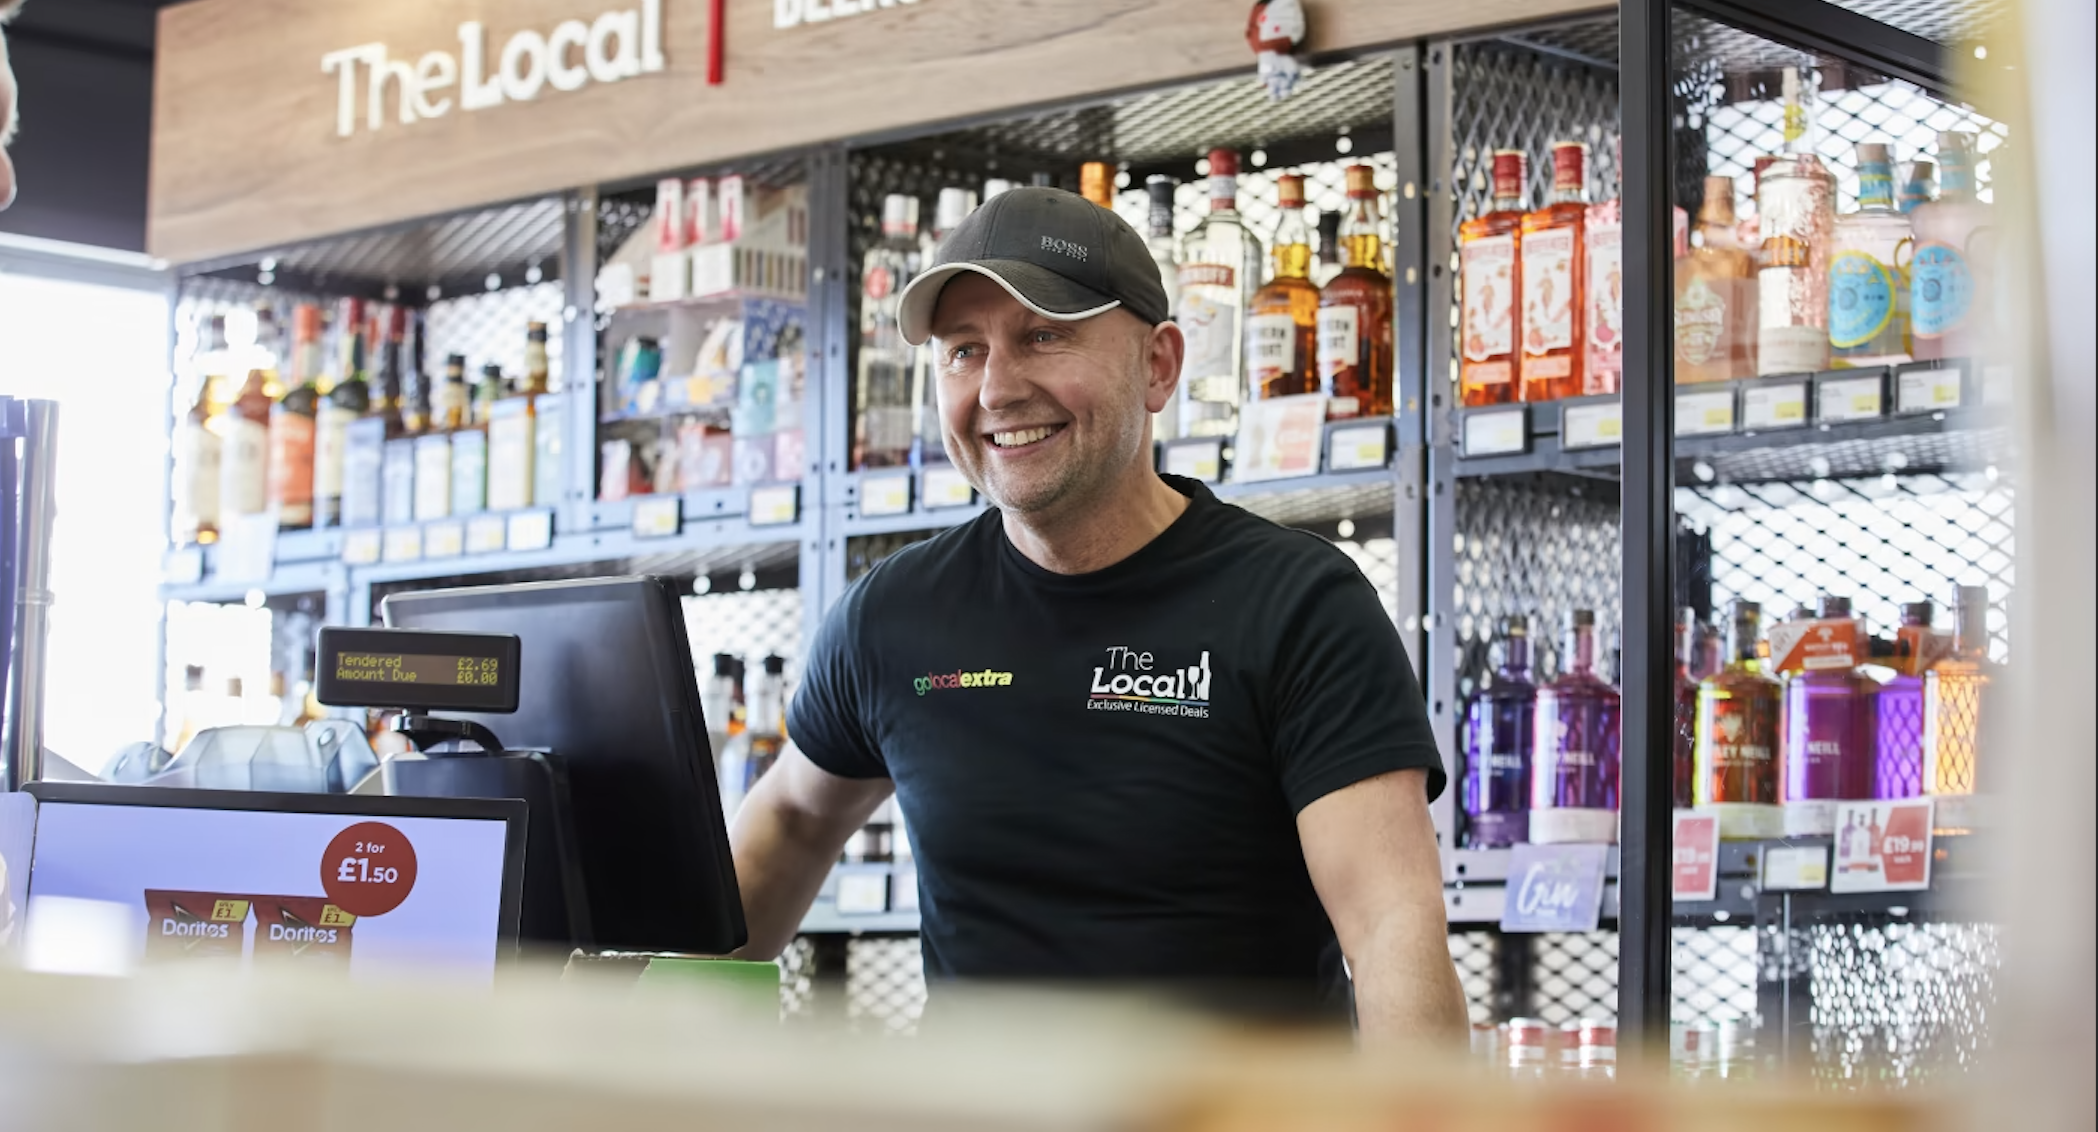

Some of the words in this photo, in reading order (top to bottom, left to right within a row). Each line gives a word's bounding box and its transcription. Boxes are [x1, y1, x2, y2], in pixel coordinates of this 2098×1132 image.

[321, 42, 457, 137] The
[457, 0, 664, 111] Local
[1040, 235, 1087, 257] BOSS
[337, 652, 402, 668] Tendered
[457, 657, 499, 671] £2.69
[1105, 645, 1154, 671] The
[336, 667, 385, 681] Amount
[392, 668, 417, 682] Due
[456, 671, 499, 685] £0.00
[1091, 666, 1186, 699] Local
[1086, 699, 1133, 711] Exclusive
[1133, 701, 1179, 716] Licensed
[1180, 705, 1210, 718] Deals
[355, 841, 364, 854] 2
[366, 841, 386, 854] for
[337, 857, 399, 884] £1.50
[162, 918, 229, 938] Doritos
[269, 923, 338, 944] Doritos
